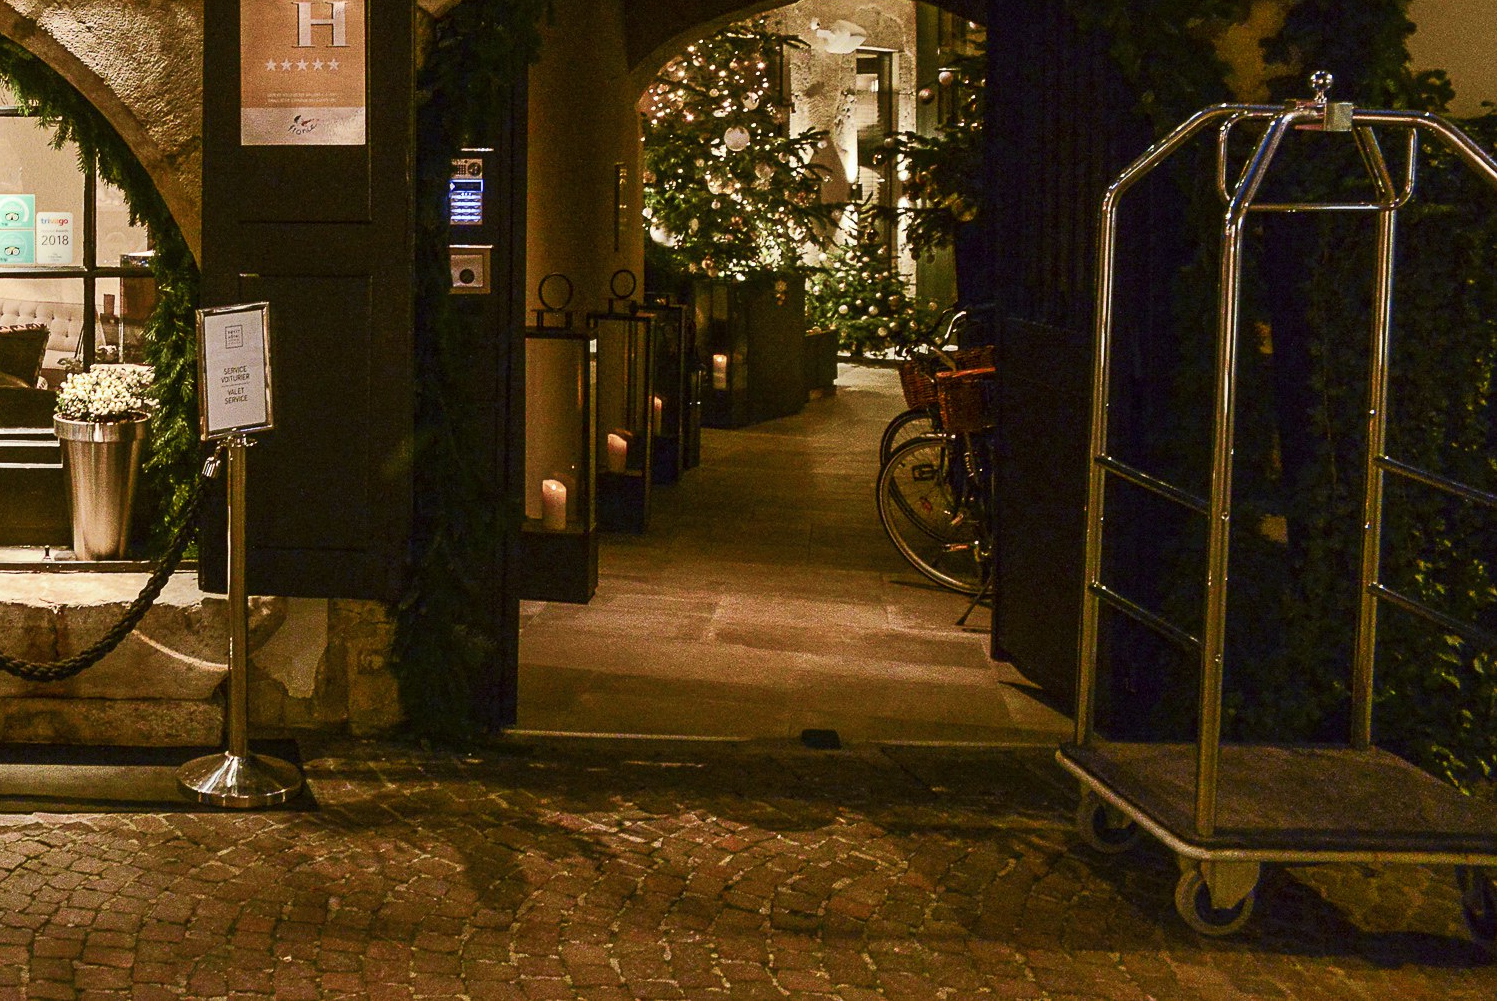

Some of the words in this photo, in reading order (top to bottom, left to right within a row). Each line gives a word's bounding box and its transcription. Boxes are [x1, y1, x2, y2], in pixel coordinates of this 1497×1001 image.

[291, 0, 351, 48] H
[41, 234, 70, 247] 2018
[223, 365, 247, 375] SERVICE
[221, 373, 250, 383] VOITURIER
[227, 387, 244, 396] VALET
[224, 395, 248, 404] SERVICE
